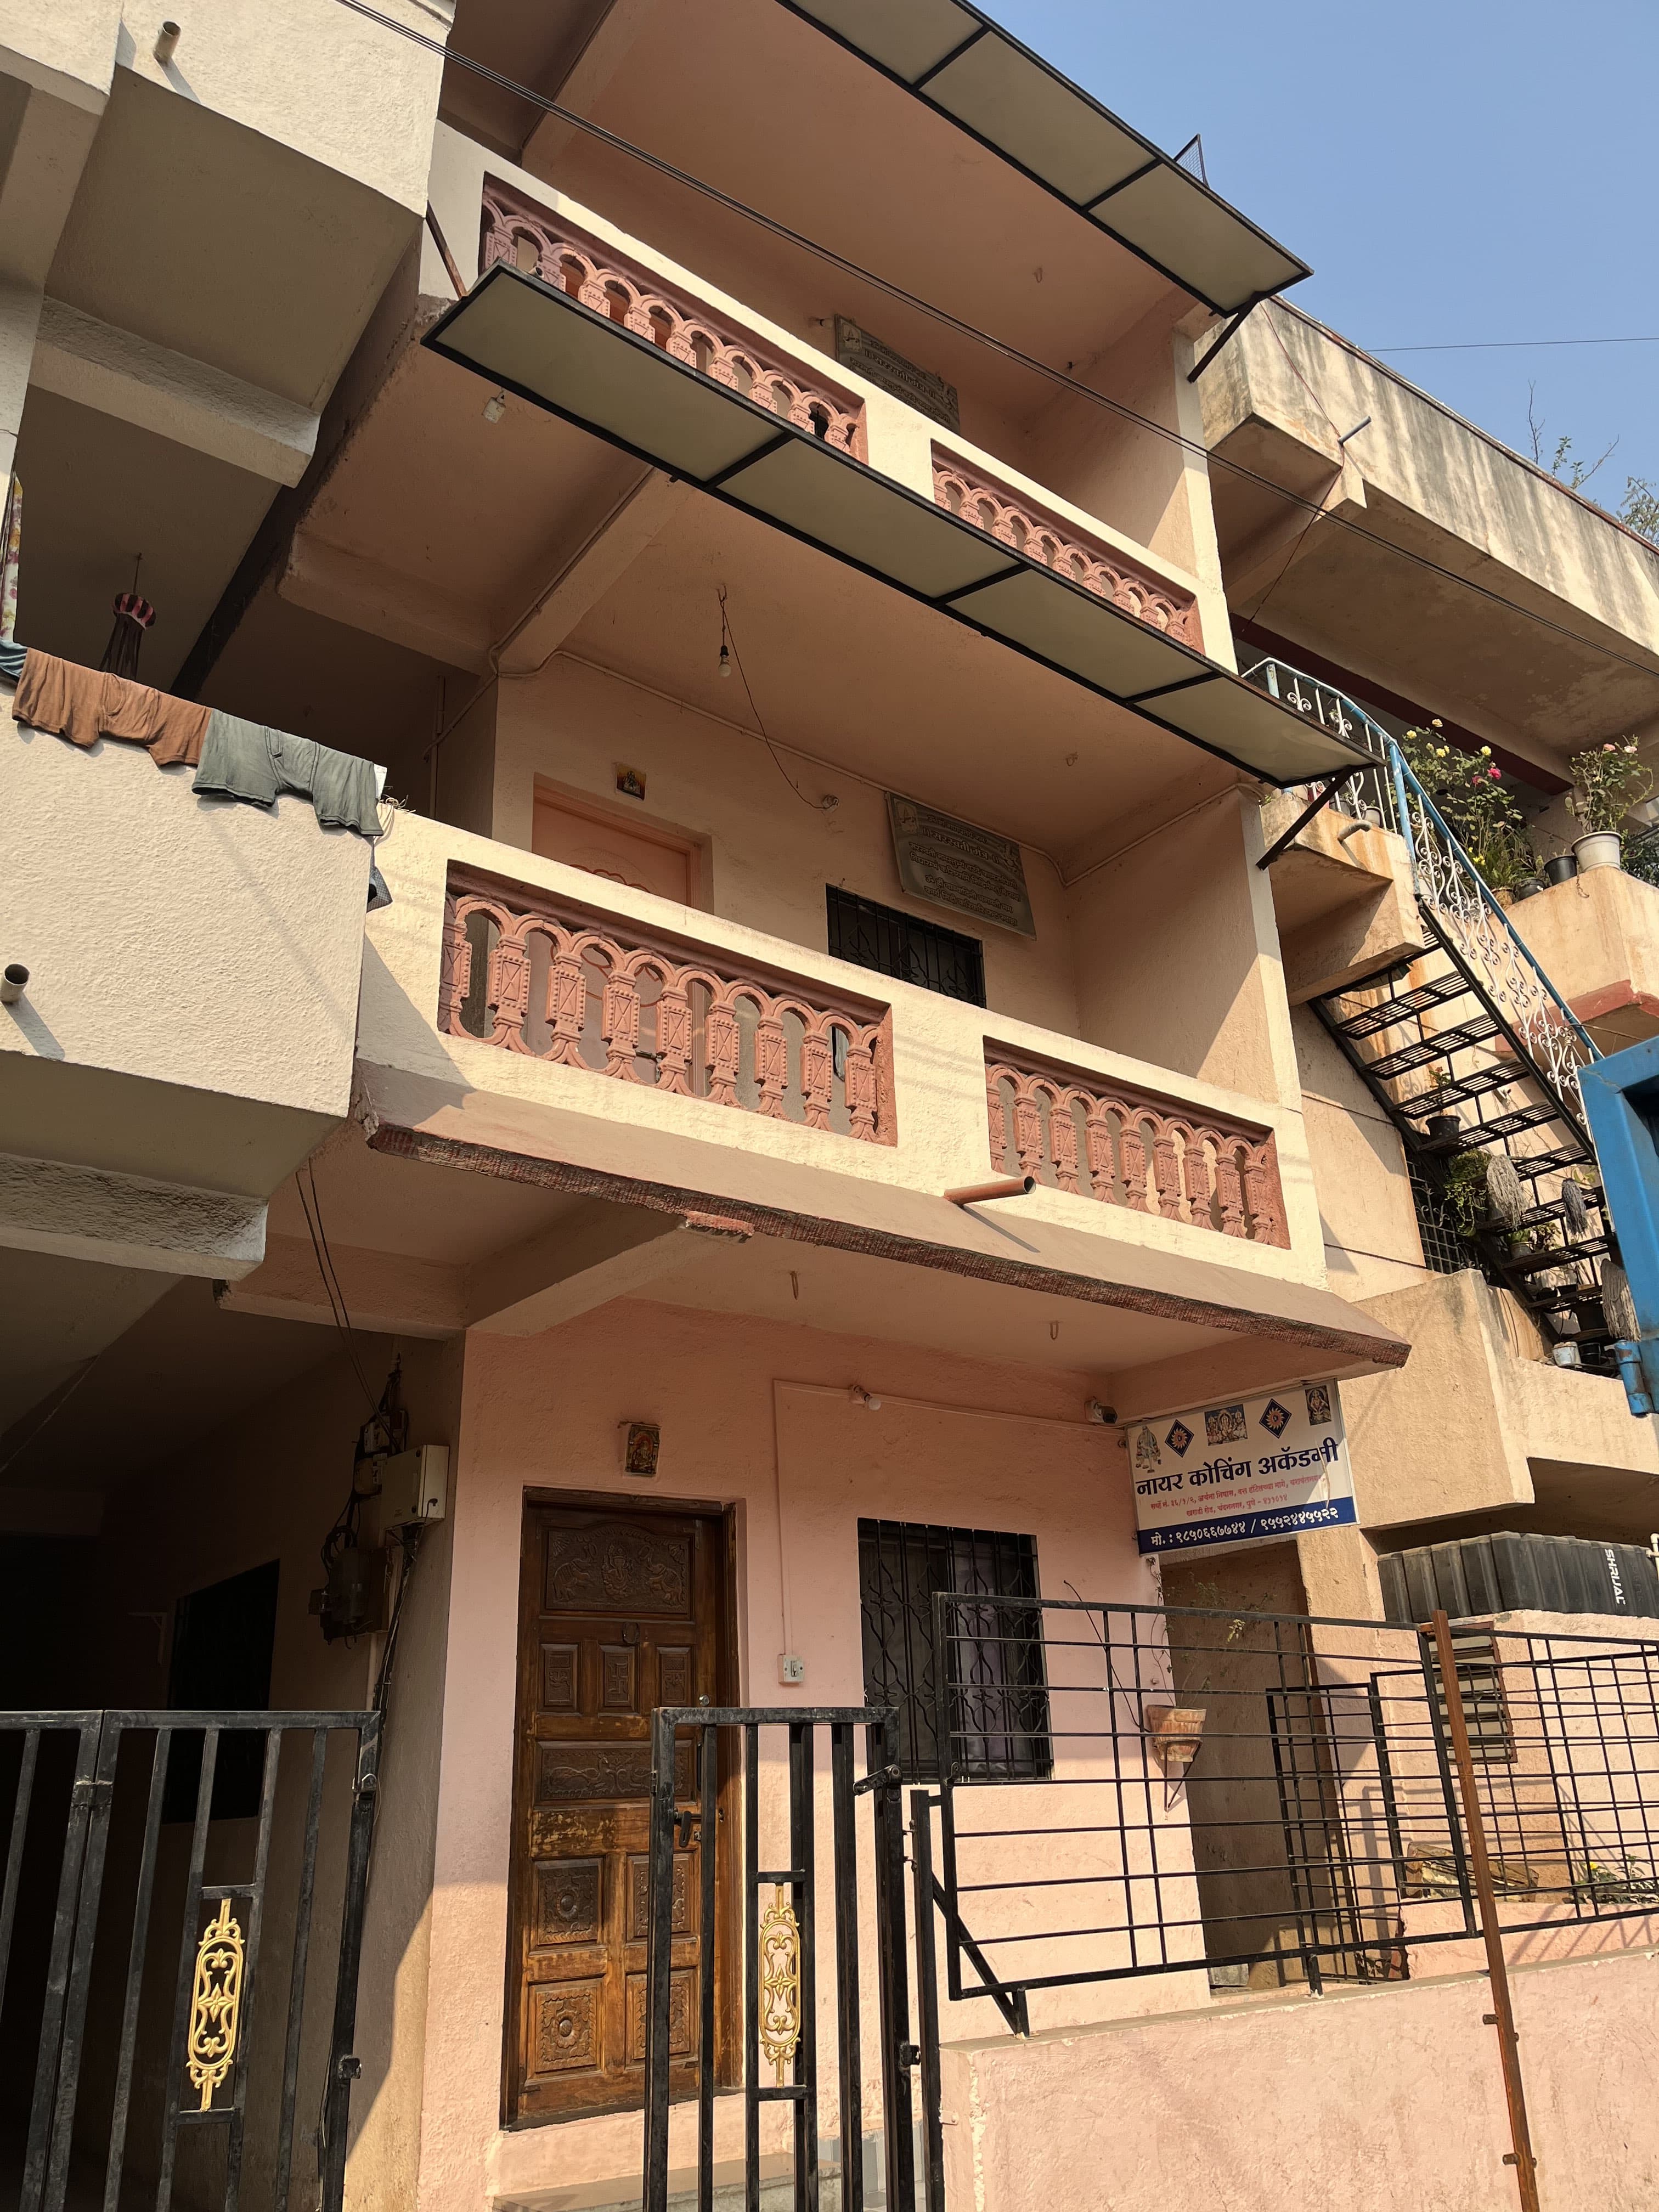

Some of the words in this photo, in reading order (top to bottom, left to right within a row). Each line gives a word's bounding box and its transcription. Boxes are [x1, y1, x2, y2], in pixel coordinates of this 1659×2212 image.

[932, 831, 970, 852] सरस्वती
[1136, 1474, 1183, 1495] नायर
[1188, 1457, 1251, 1486] कोचिंग
[1176, 1521, 1245, 1543] ९८५०६६७७४४
[1261, 1506, 1339, 1530] ९५५२४४५५२२
